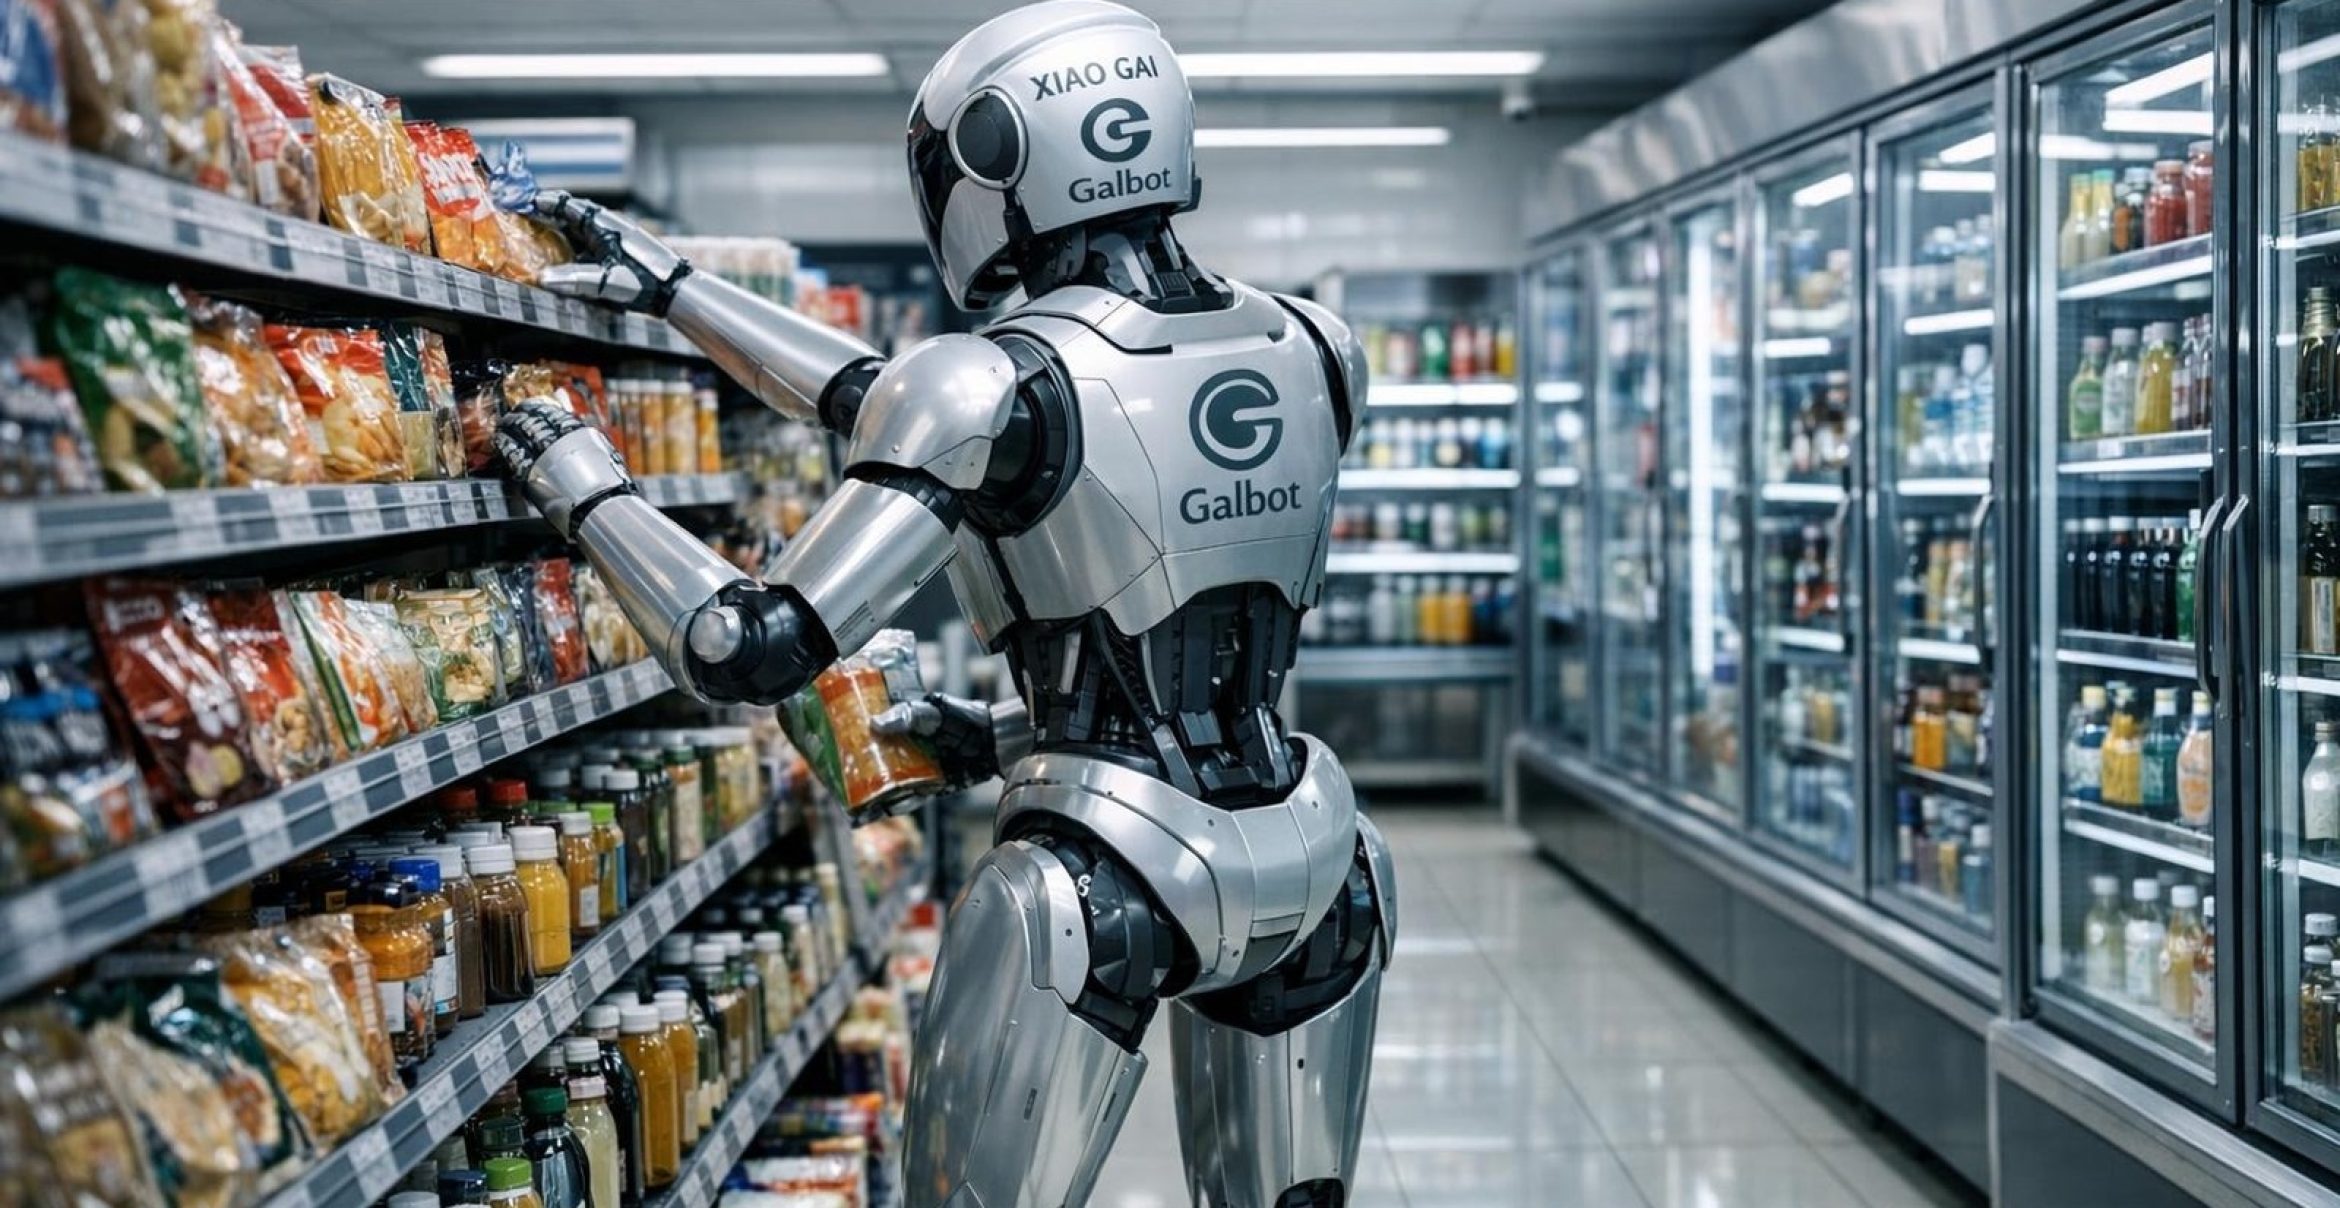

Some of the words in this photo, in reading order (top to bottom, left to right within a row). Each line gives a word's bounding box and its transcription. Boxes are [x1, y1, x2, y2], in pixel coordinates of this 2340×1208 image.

[1030, 62, 1106, 101] XIAO
[1114, 55, 1158, 80] GAI
[1069, 168, 1171, 203] Galbot
[1180, 479, 1302, 524] Galbot
